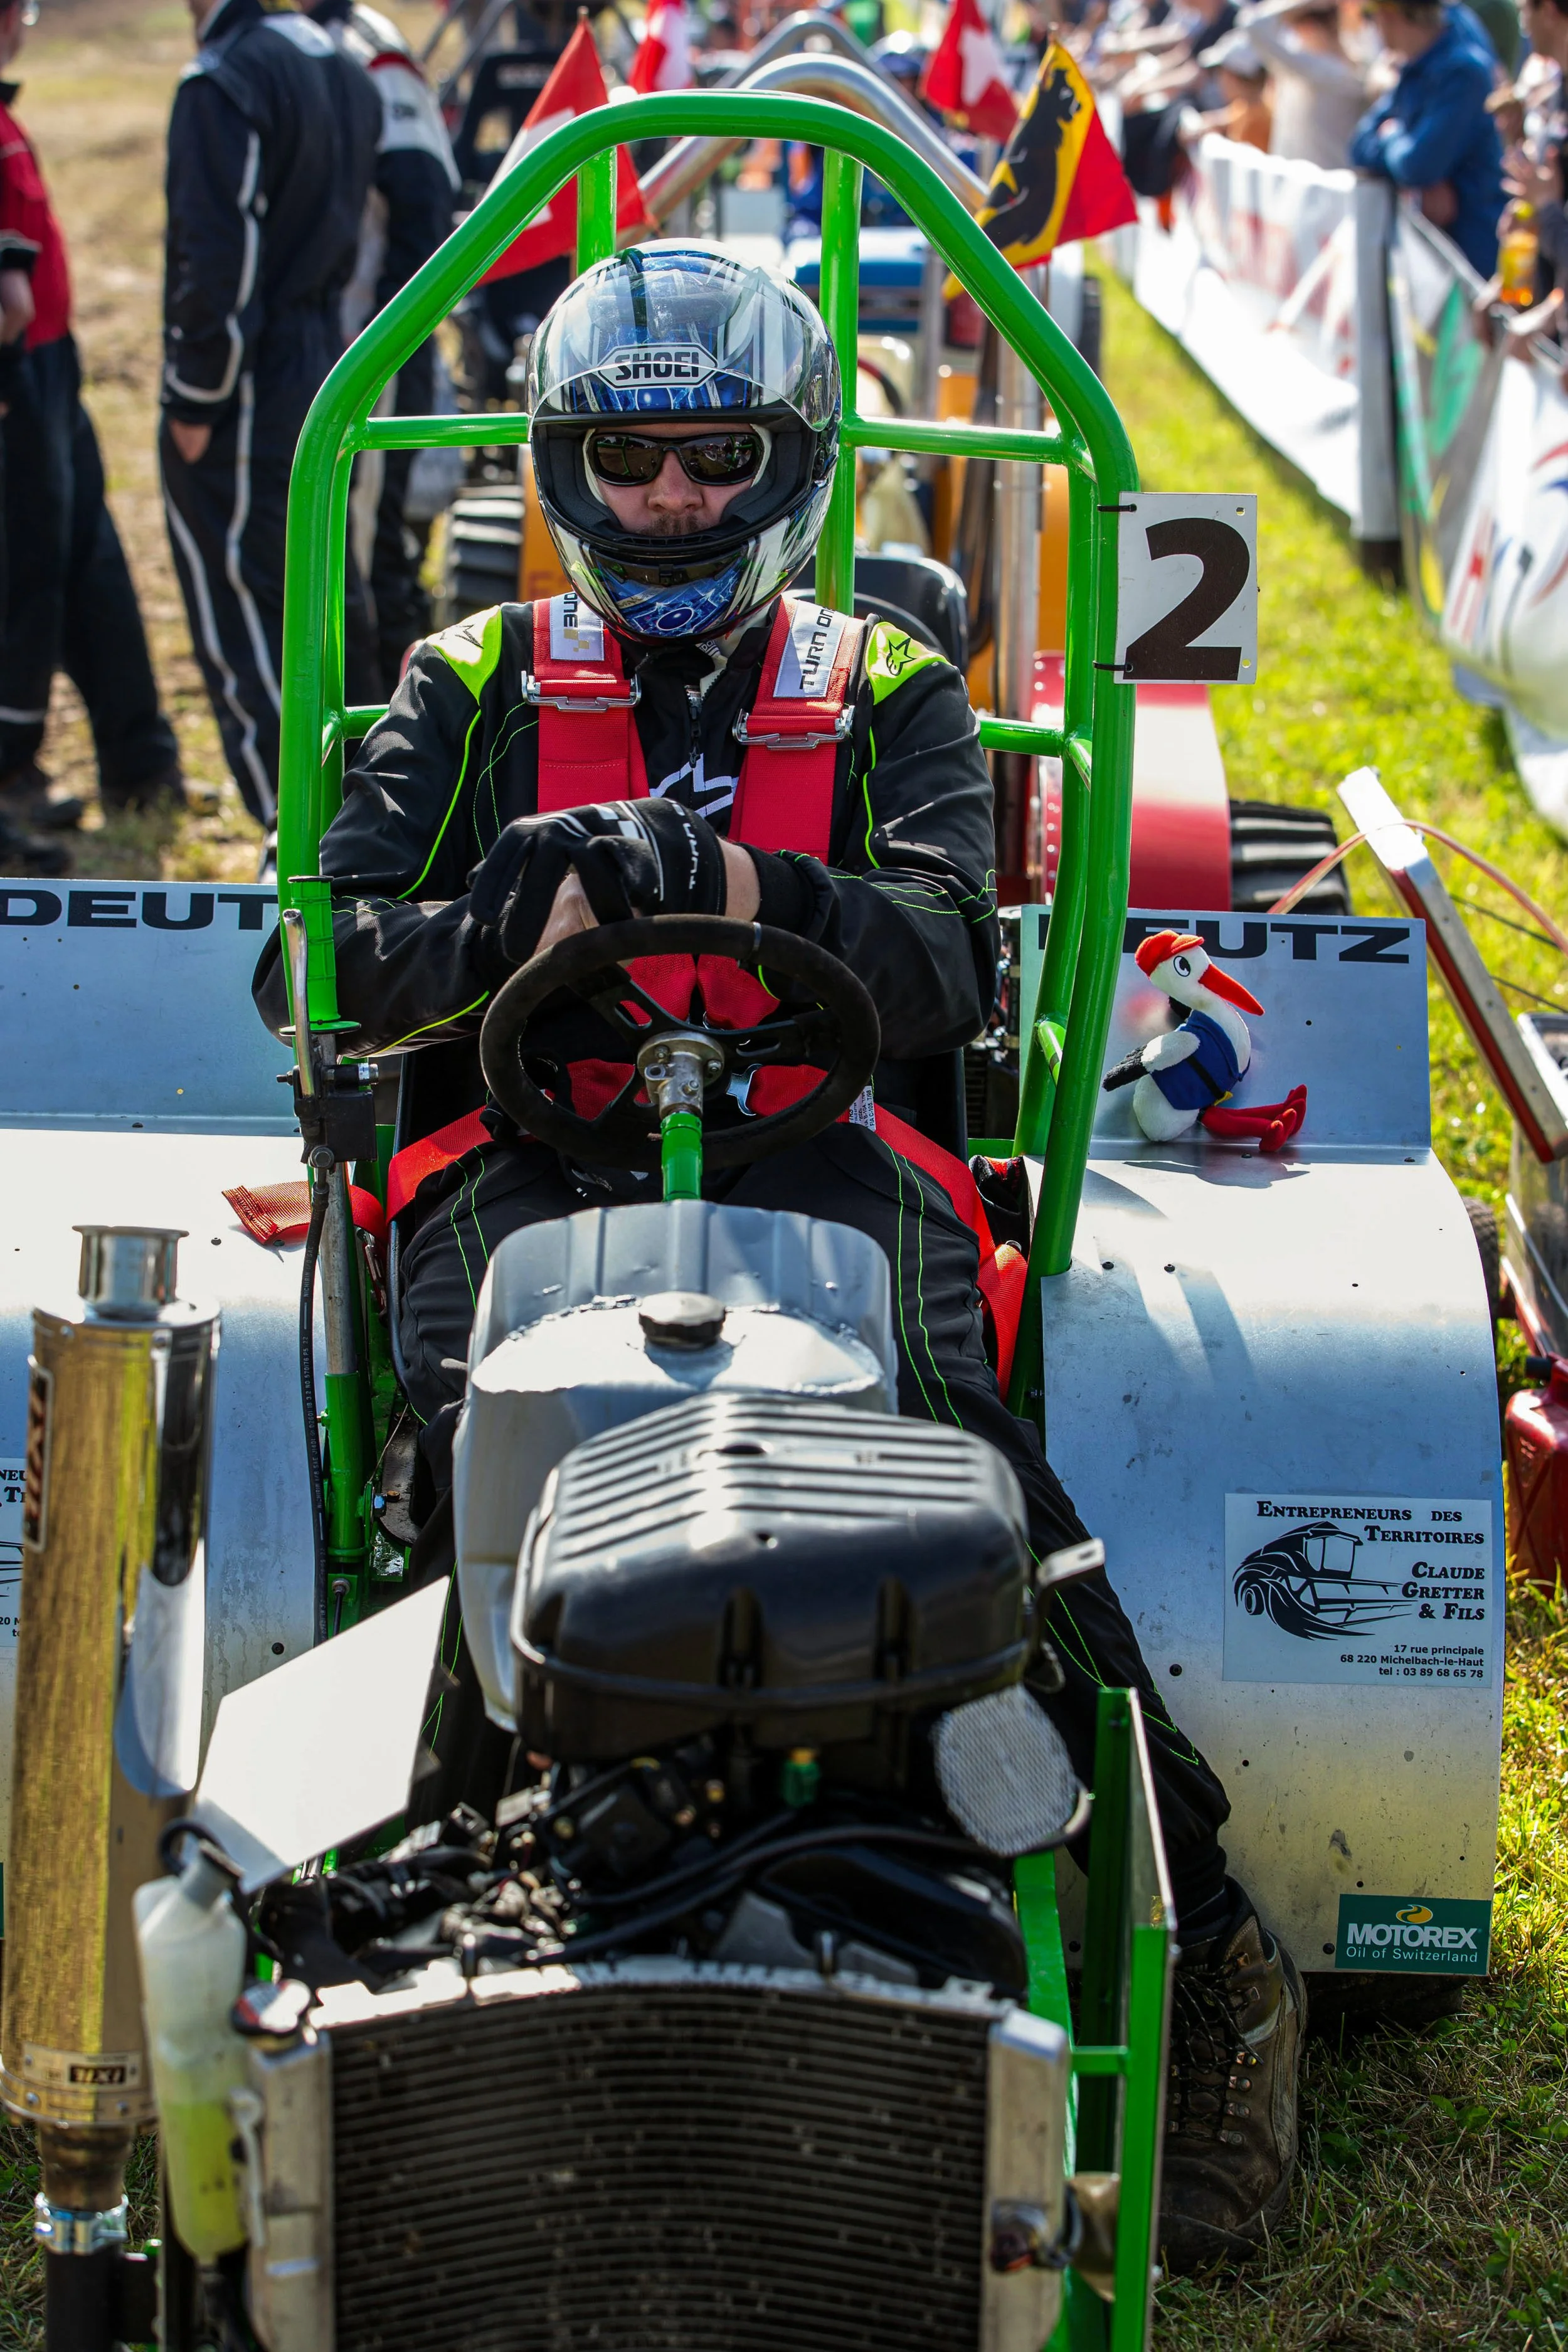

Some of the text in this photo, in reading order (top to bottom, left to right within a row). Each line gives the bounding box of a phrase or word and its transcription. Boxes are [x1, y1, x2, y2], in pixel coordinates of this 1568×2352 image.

[615, 351, 699, 381] SHOEI
[1123, 517, 1250, 681] 2
[799, 607, 836, 690] TURN ON
[682, 823, 699, 890] TURN
[0, 889, 279, 930] DEUT
[1039, 914, 1410, 963] EUTZ
[302, 1336, 309, 1344] 22
[1257, 1501, 1462, 1522] ENTREPRENEURS DES
[1364, 1525, 1485, 1545] TERRITOIRES
[1412, 1561, 1485, 1579] CLAUDE
[1402, 1581, 1485, 1600] GRETTER
[1418, 1603, 1485, 1621] & FILS
[1340, 1654, 1484, 1666] 68 220 Michelbach-le-Haut
[1394, 1645, 1407, 1653] 17
[1431, 1645, 1484, 1656] principale
[1379, 1666, 1393, 1675] tel
[1403, 1668, 1416, 1677] 03
[1420, 1668, 1433, 1677] 89
[1436, 1668, 1449, 1677] 68
[1453, 1668, 1466, 1677] 65
[1470, 1669, 1483, 1678] 78
[1347, 1923, 1477, 1949] MOTOREX
[1346, 1946, 1477, 1963] Oil of Switzerland
